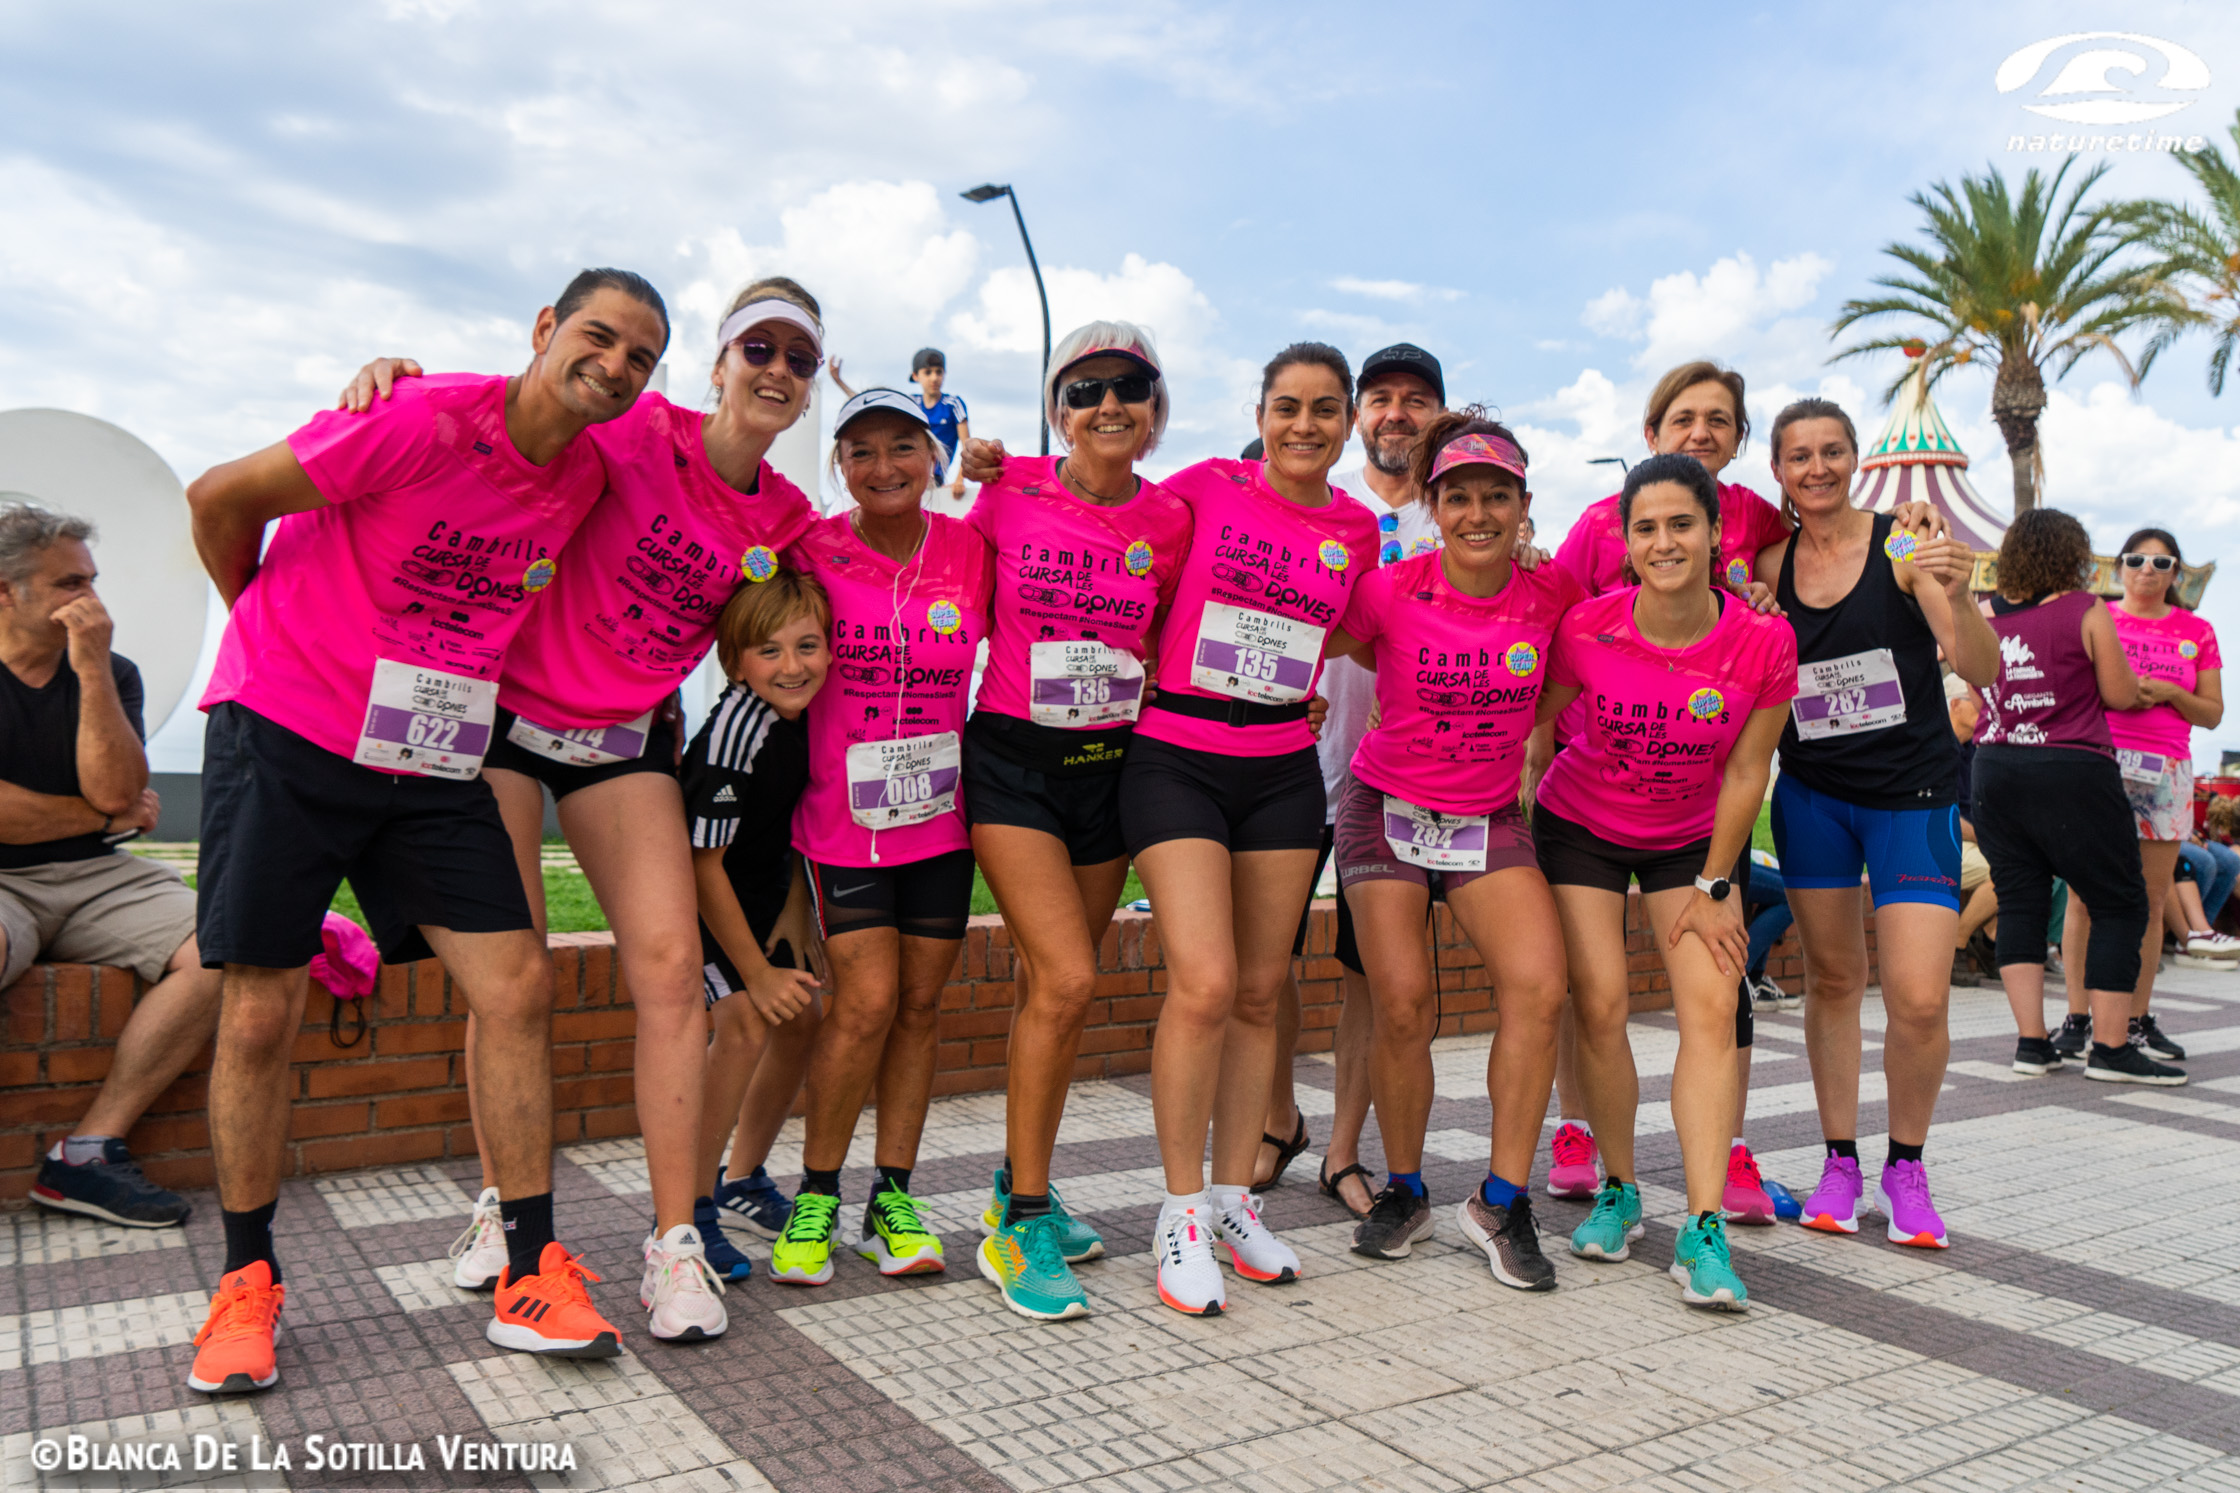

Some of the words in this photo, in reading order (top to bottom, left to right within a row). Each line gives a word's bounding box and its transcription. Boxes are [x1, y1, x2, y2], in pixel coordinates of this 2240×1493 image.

[428, 520, 548, 561] Cambrils
[412, 545, 473, 570] CURSA
[475, 556, 491, 568] DE
[636, 537, 692, 580] CURSA
[693, 569, 710, 583] DE
[1127, 550, 1150, 562] SUPER
[1214, 545, 1270, 575] CURSA
[1274, 561, 1289, 573] DE
[1322, 547, 1344, 558] SUPER
[1129, 559, 1151, 570] TEAM
[1325, 556, 1346, 566] TEAM
[1019, 565, 1074, 589] CURSA
[1077, 570, 1092, 582] DE
[1270, 571, 1290, 583] LES
[456, 571, 525, 603] DONES
[1075, 581, 1093, 592] LES
[672, 586, 725, 617] DONE
[1074, 592, 1147, 620] DONES
[1211, 587, 1266, 611] #Respectam
[1264, 581, 1337, 624] DONES
[929, 608, 956, 620] SUPER
[1019, 607, 1078, 622] #Respectam
[1238, 611, 1292, 632] Cambrils
[431, 617, 484, 641] icctelecom
[931, 617, 957, 628] TEAM
[1235, 622, 1259, 634] CURSA
[1257, 636, 1288, 650] DONES
[837, 644, 892, 664] CURSA
[894, 655, 912, 666] LES
[1065, 655, 1089, 663] CURSA
[1509, 652, 1534, 662] SUPER
[1089, 664, 1118, 674] DONES
[1234, 647, 1279, 682] 135
[1510, 660, 1534, 671] TEAM
[1812, 660, 1862, 675] Cambrils
[416, 673, 473, 693] Cambrils
[894, 667, 964, 689] DONES
[1416, 670, 1470, 688] CURSA
[1474, 669, 1489, 680] DE
[1473, 678, 1490, 688] LES
[1836, 674, 1865, 686] DONES
[843, 688, 899, 700] #Respectam
[1069, 677, 1111, 705] 136
[1247, 688, 1284, 702] icctelecom
[1470, 684, 1539, 707] DONES
[436, 700, 468, 713] DONES
[1690, 695, 1719, 711] SUPER
[1694, 702, 1721, 717] TEAM
[1824, 688, 1870, 717] 282
[406, 713, 461, 751] 622
[1597, 715, 1647, 737] CURSA
[1650, 722, 1667, 731] DE
[1462, 730, 1508, 739] icctelecom
[1649, 731, 1667, 740] LES
[881, 741, 933, 754] Cambrils
[1646, 740, 1720, 759] DONES
[905, 757, 931, 770] DONES
[1063, 748, 1124, 766] HANKER
[886, 773, 933, 806] 008
[1411, 822, 1455, 849] 284
[1427, 858, 1464, 867] icctelecom
[1004, 1234, 1028, 1278] HOKA
